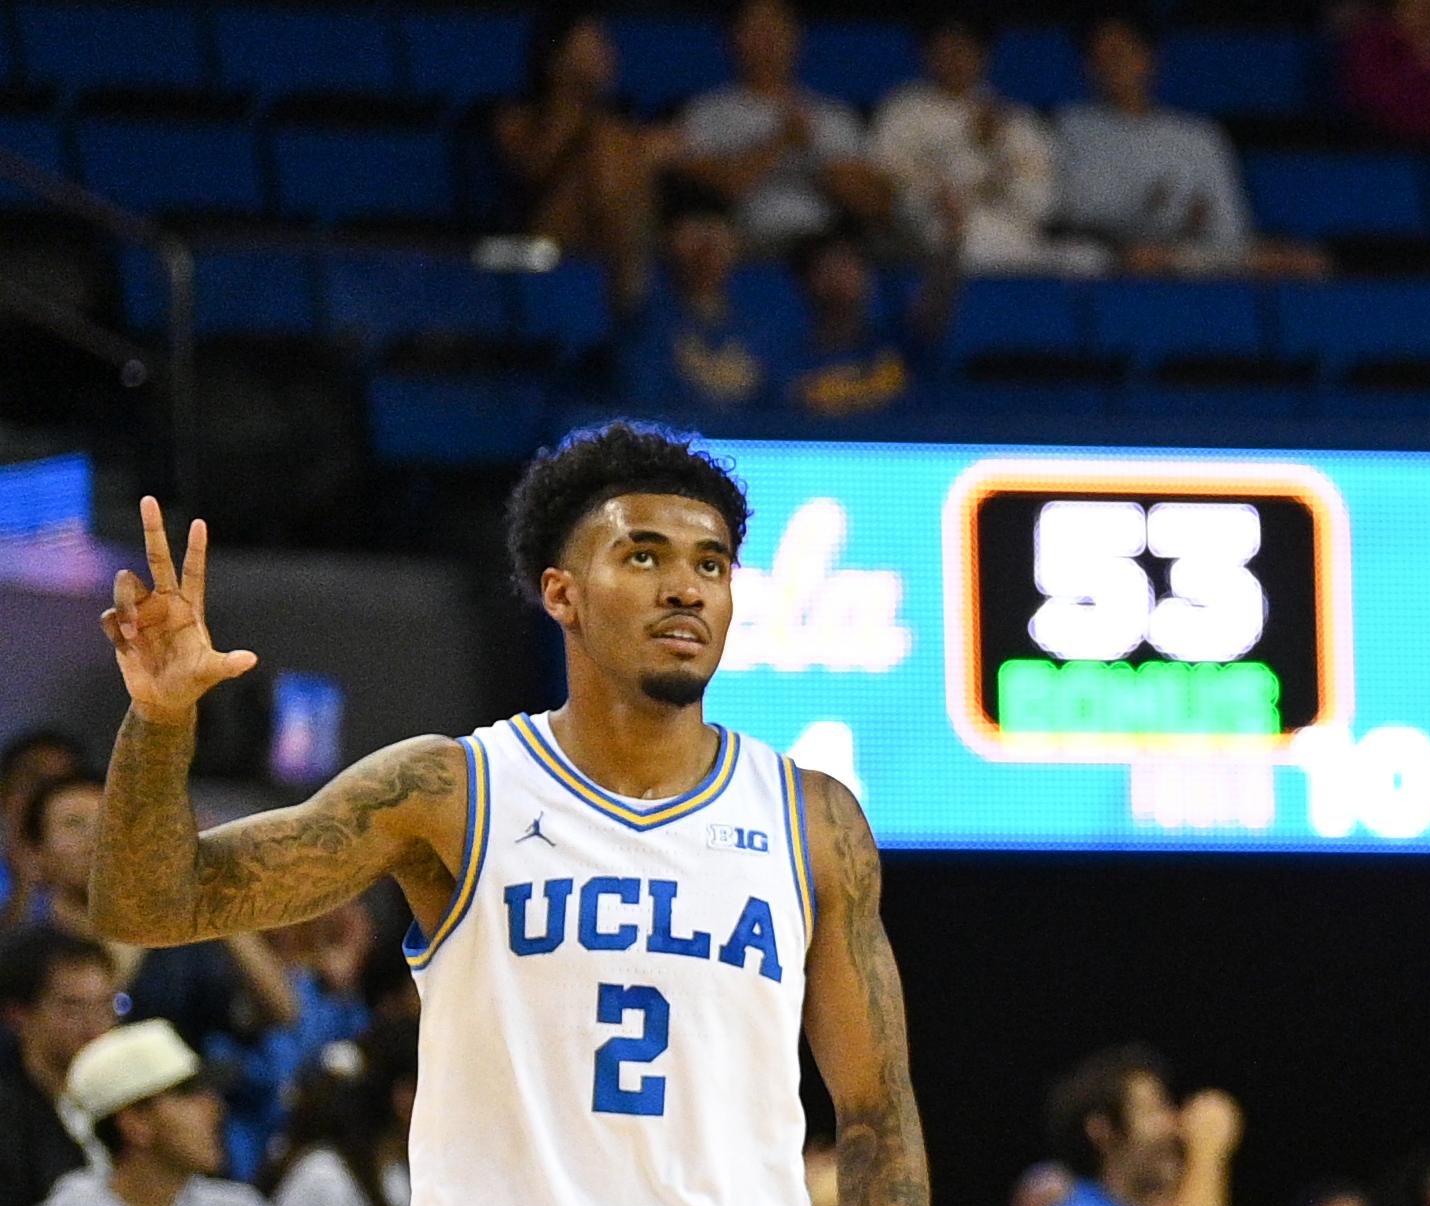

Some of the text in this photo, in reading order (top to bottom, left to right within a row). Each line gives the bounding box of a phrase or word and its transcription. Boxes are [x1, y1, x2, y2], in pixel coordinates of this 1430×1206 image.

[1029, 501, 1268, 662] 53
[503, 877, 783, 984] UCLA
[591, 982, 670, 1116] 2
